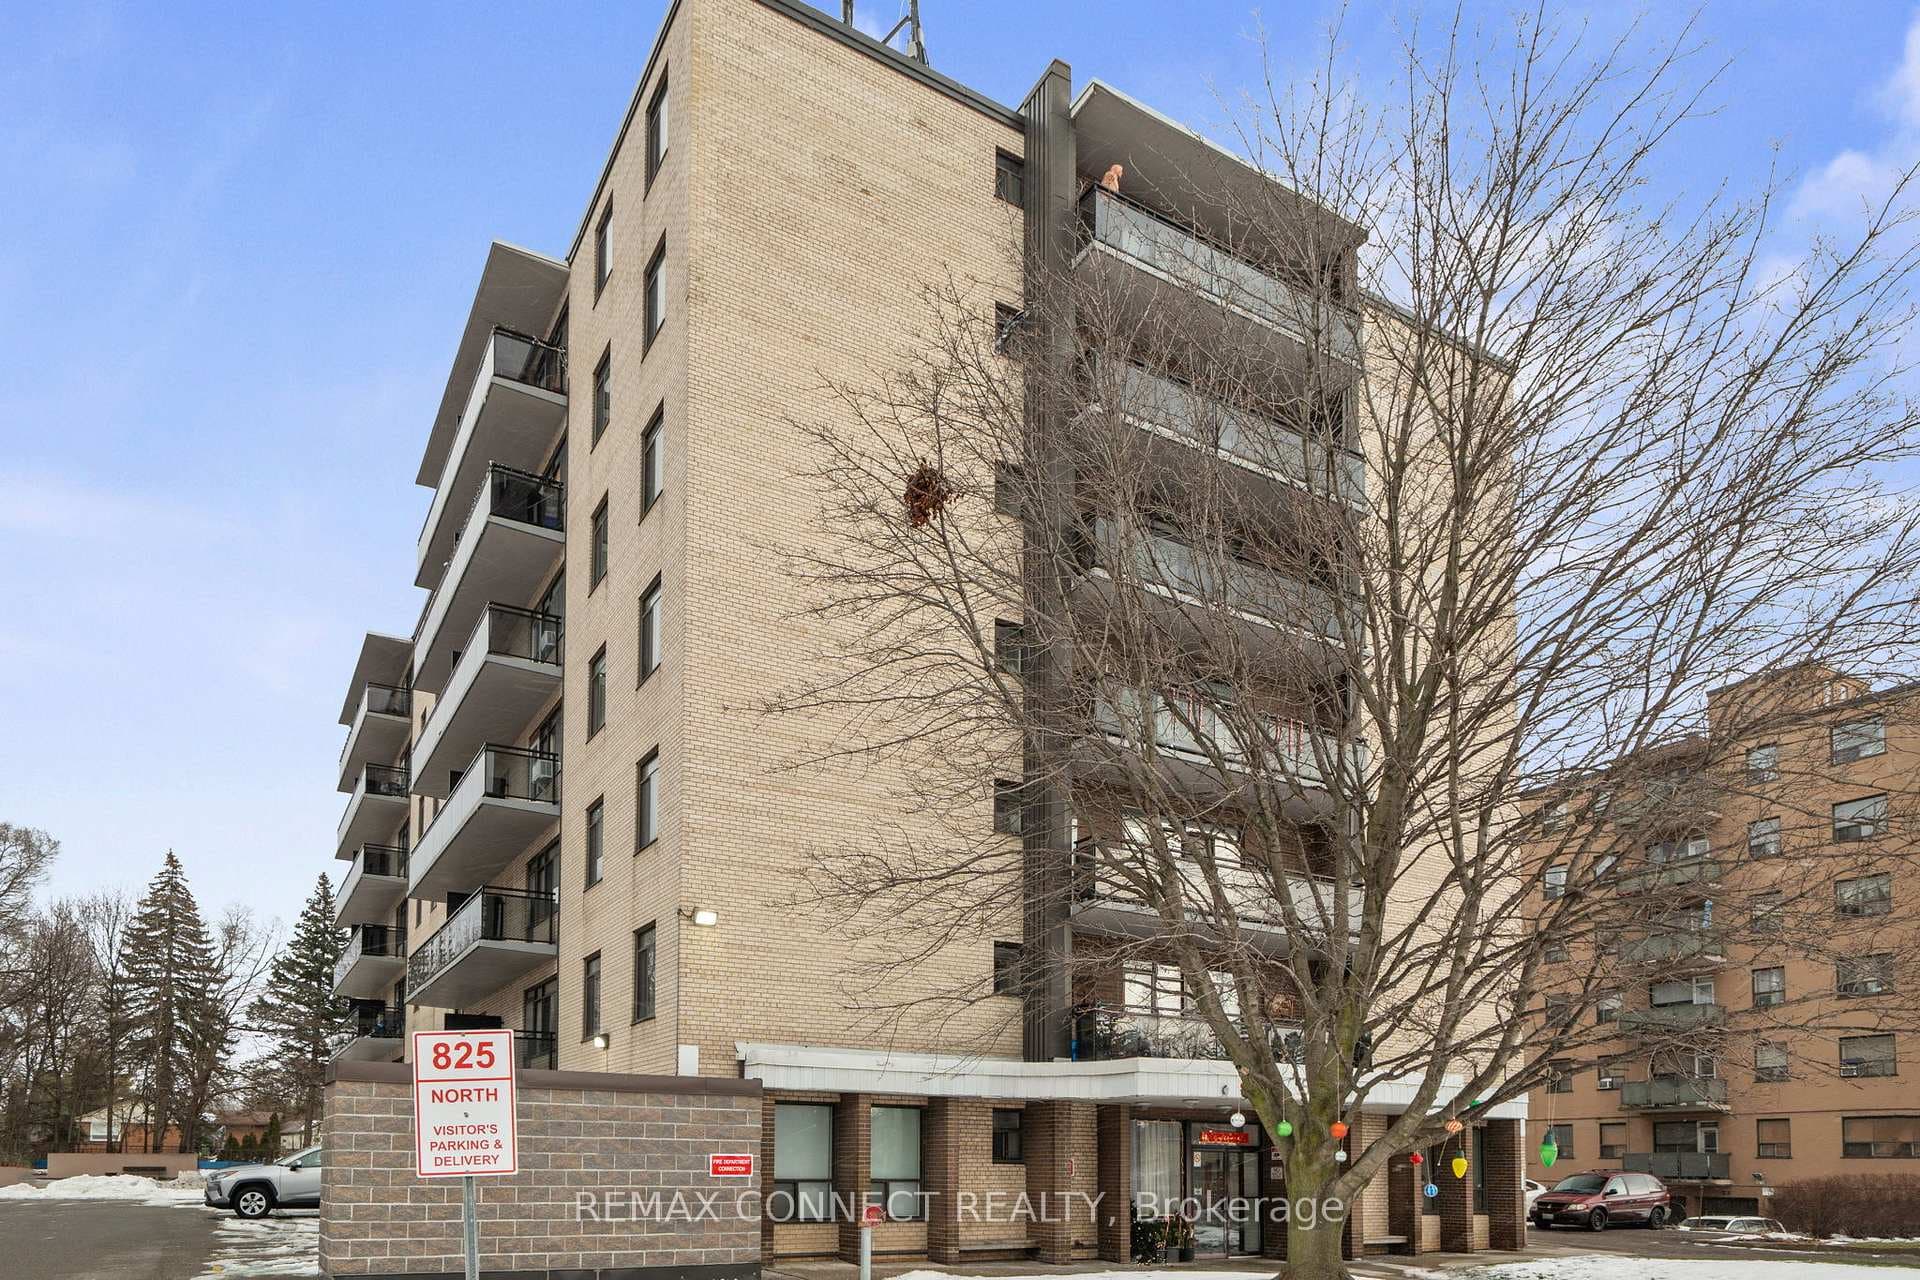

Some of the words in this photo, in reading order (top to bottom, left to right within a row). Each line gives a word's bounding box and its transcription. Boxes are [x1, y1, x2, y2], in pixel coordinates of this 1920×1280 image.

[432, 1041, 496, 1070] 825
[431, 1088, 498, 1103] NORTH
[433, 1124, 498, 1136] VISITOR'S
[430, 1140, 490, 1151] PARKING
[493, 1139, 503, 1149] &
[434, 1154, 499, 1167] DELIVERY
